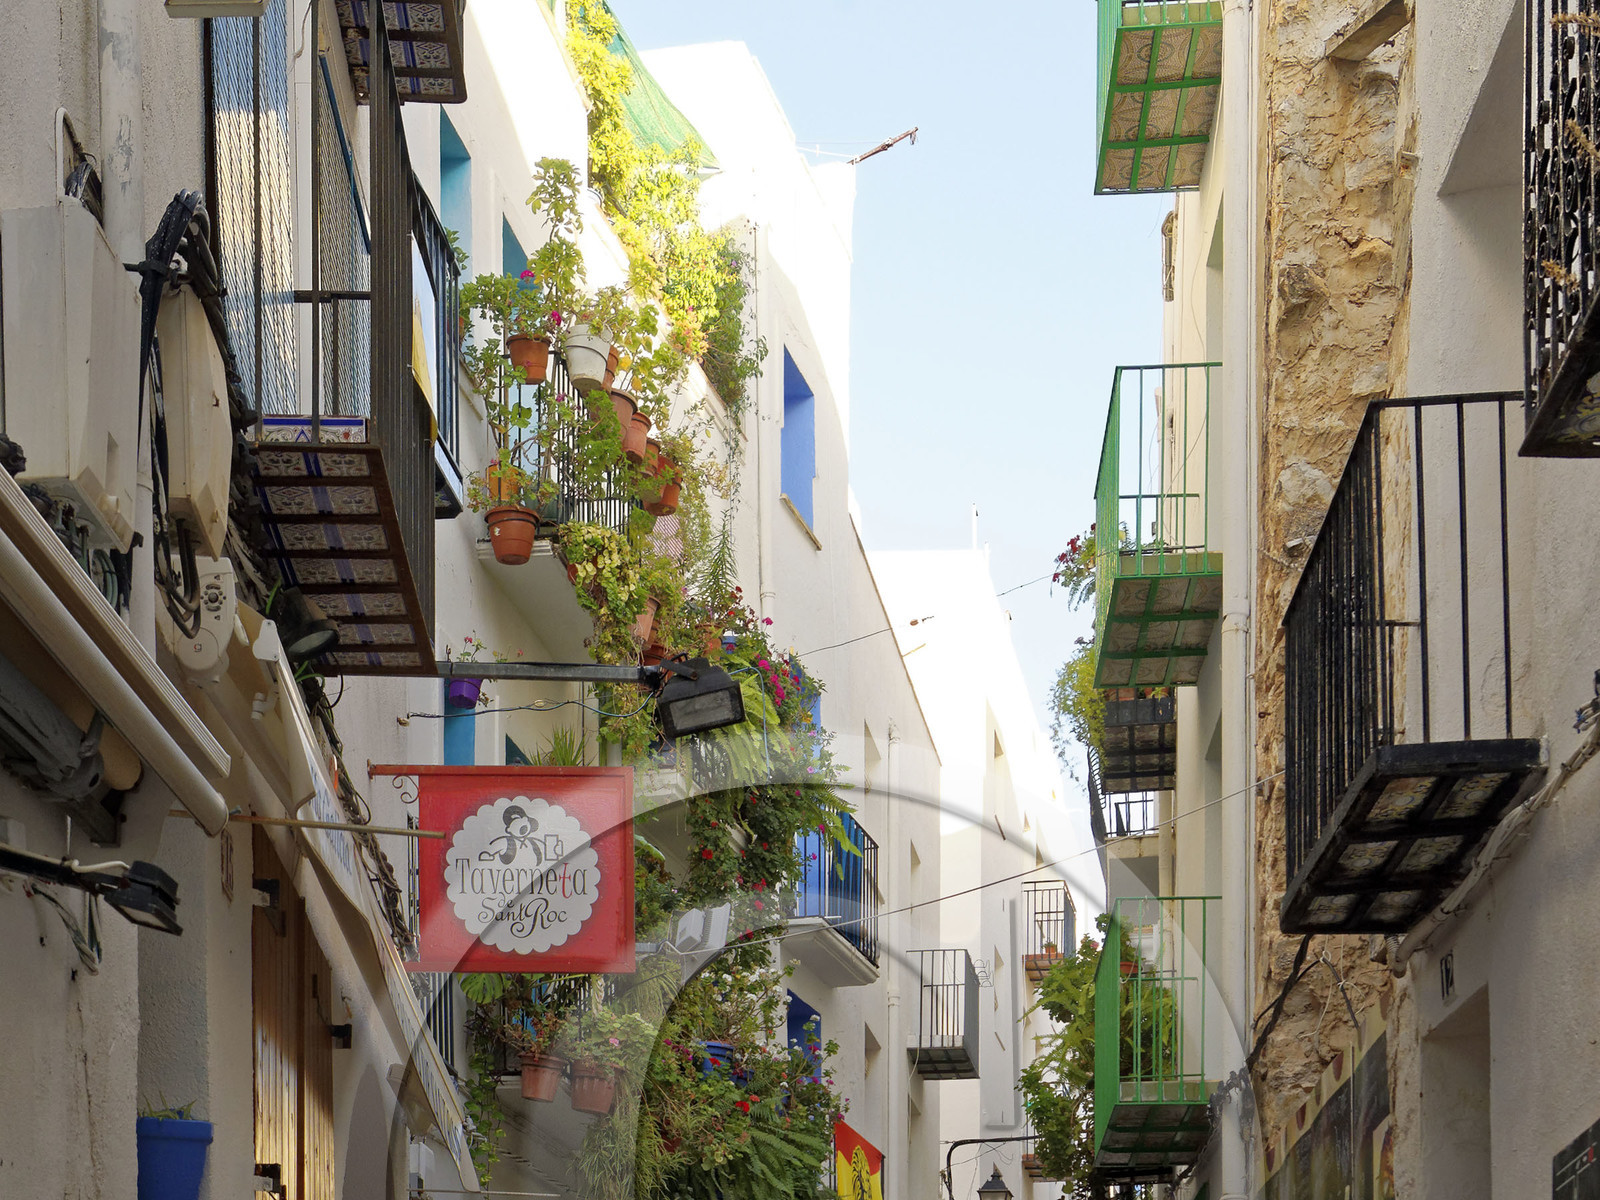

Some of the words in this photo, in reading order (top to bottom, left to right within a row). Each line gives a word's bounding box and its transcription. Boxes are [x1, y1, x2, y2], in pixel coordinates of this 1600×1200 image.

[455, 858, 587, 899] Taverneta
[478, 896, 525, 923] Sant
[510, 897, 567, 938] Roc
[498, 891, 514, 908] de
